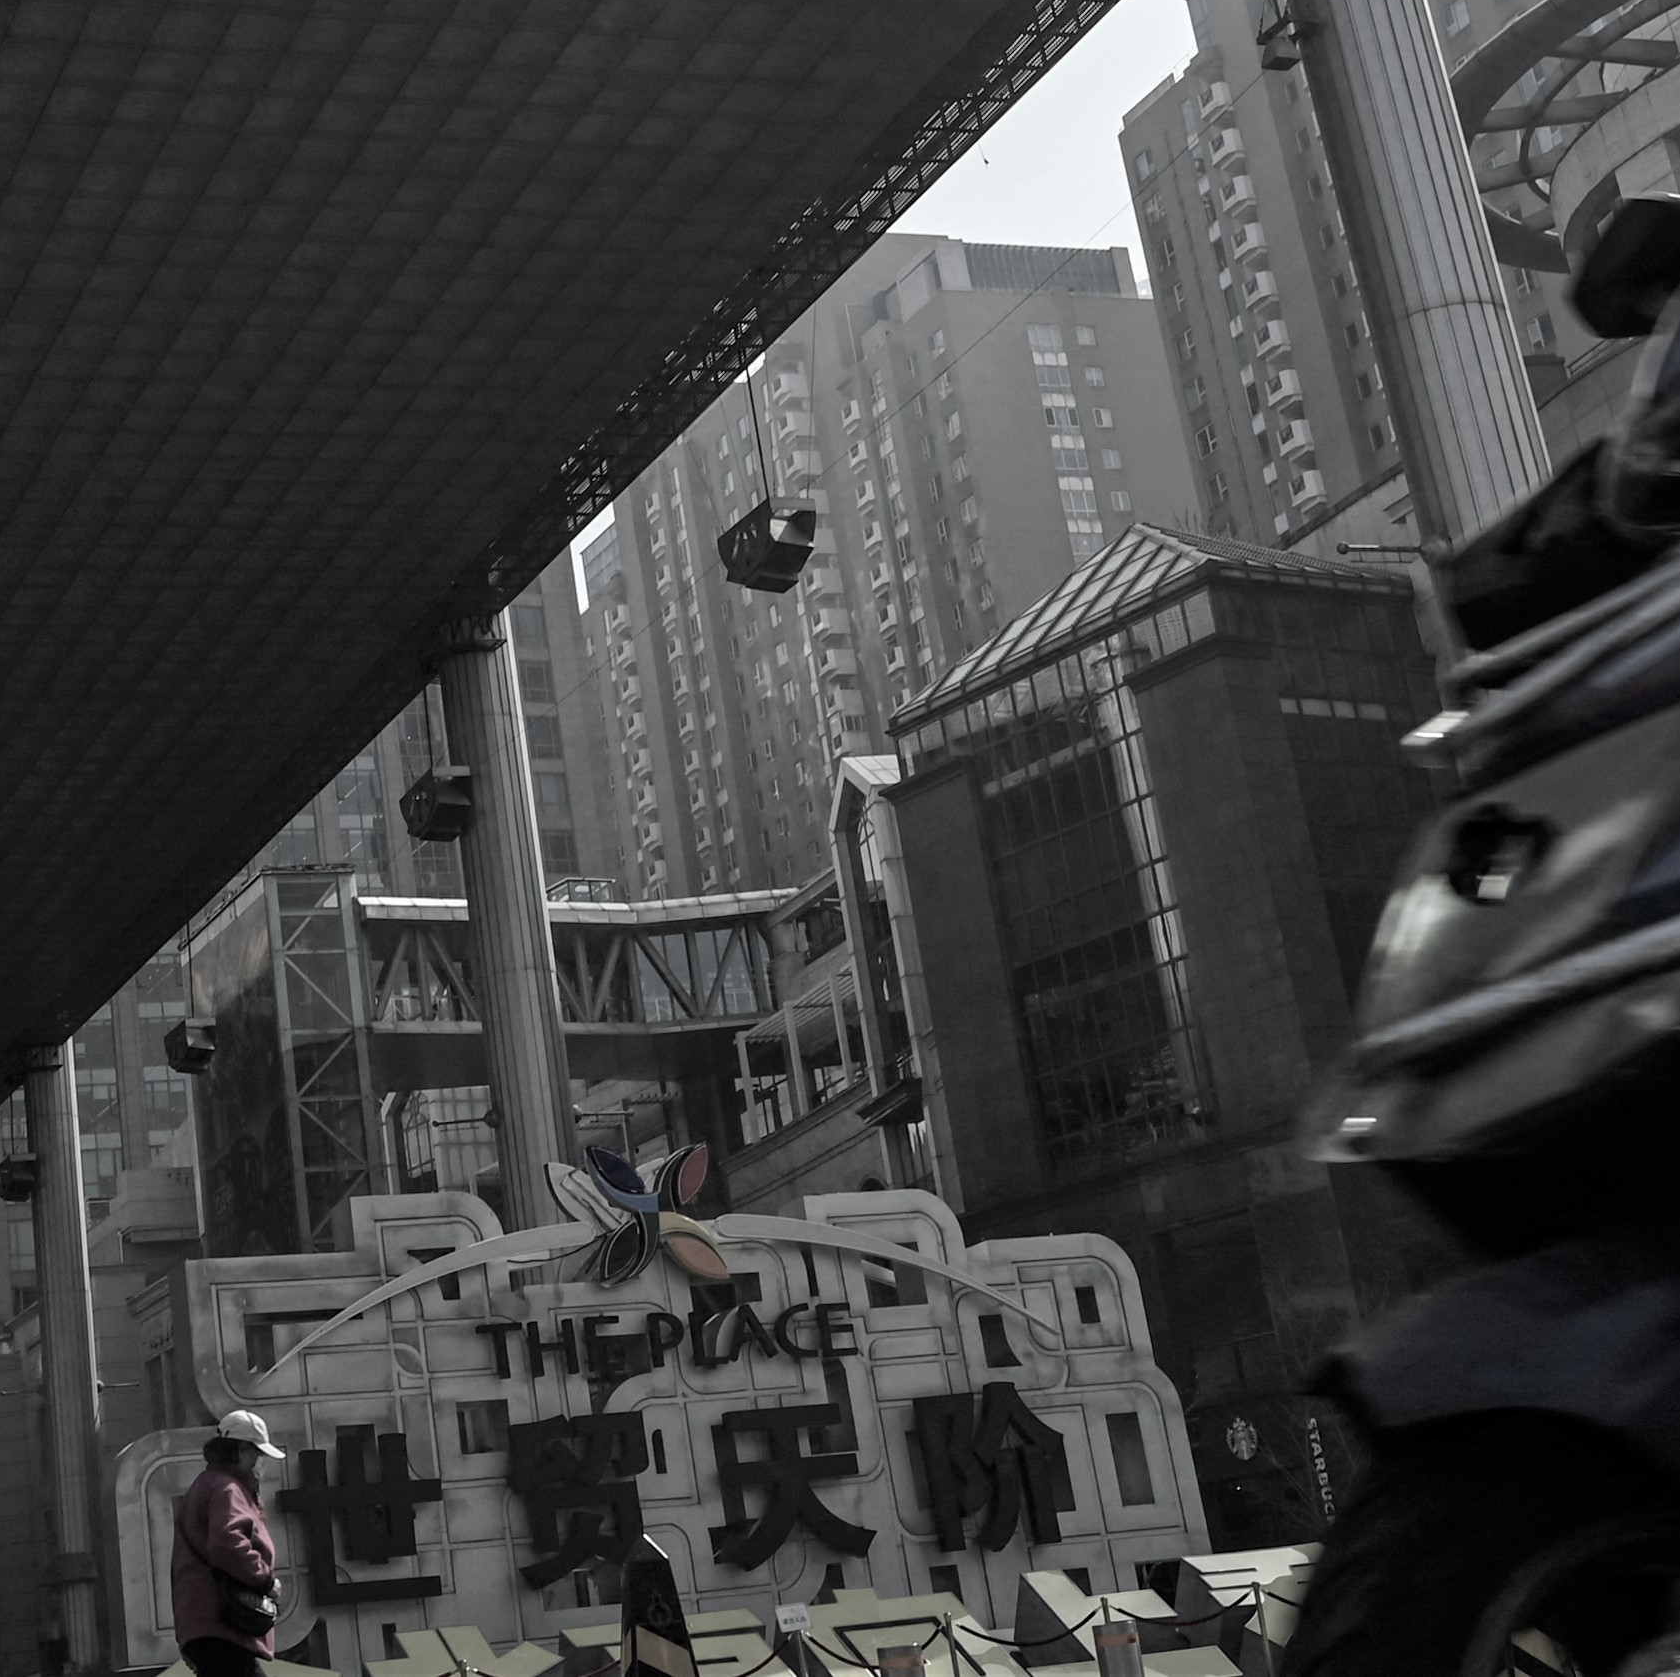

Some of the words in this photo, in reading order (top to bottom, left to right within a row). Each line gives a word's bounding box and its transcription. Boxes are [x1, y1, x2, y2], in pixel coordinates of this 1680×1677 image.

[476, 1314, 619, 1380] THE
[646, 1302, 858, 1368] PLACE
[280, 1381, 1067, 1604] 世贸天阶
